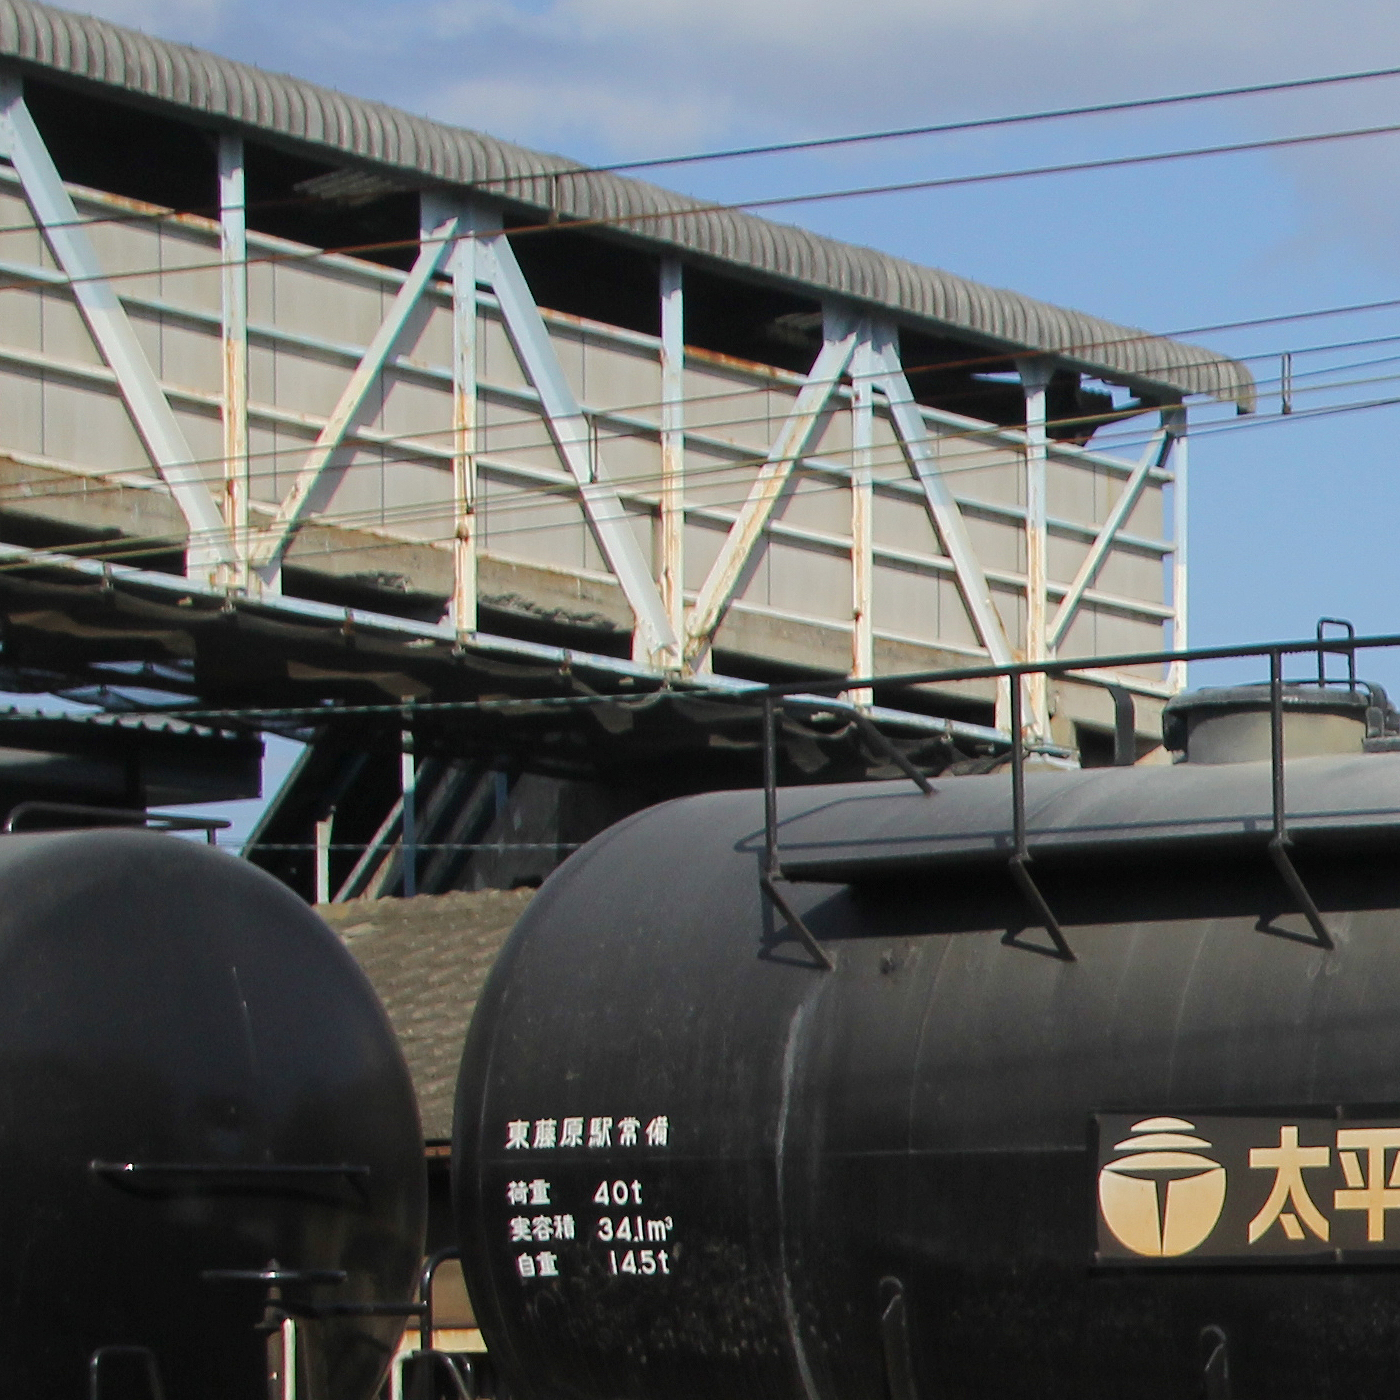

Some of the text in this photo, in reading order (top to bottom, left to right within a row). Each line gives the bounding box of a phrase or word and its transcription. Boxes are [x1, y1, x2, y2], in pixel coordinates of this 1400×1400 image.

[505, 1115, 669, 1149] 東藤原駅常備
[508, 1179, 642, 1206] 荷重 40t
[510, 1213, 575, 1242] 実容積
[517, 1250, 669, 1277] 自重 14.5t
